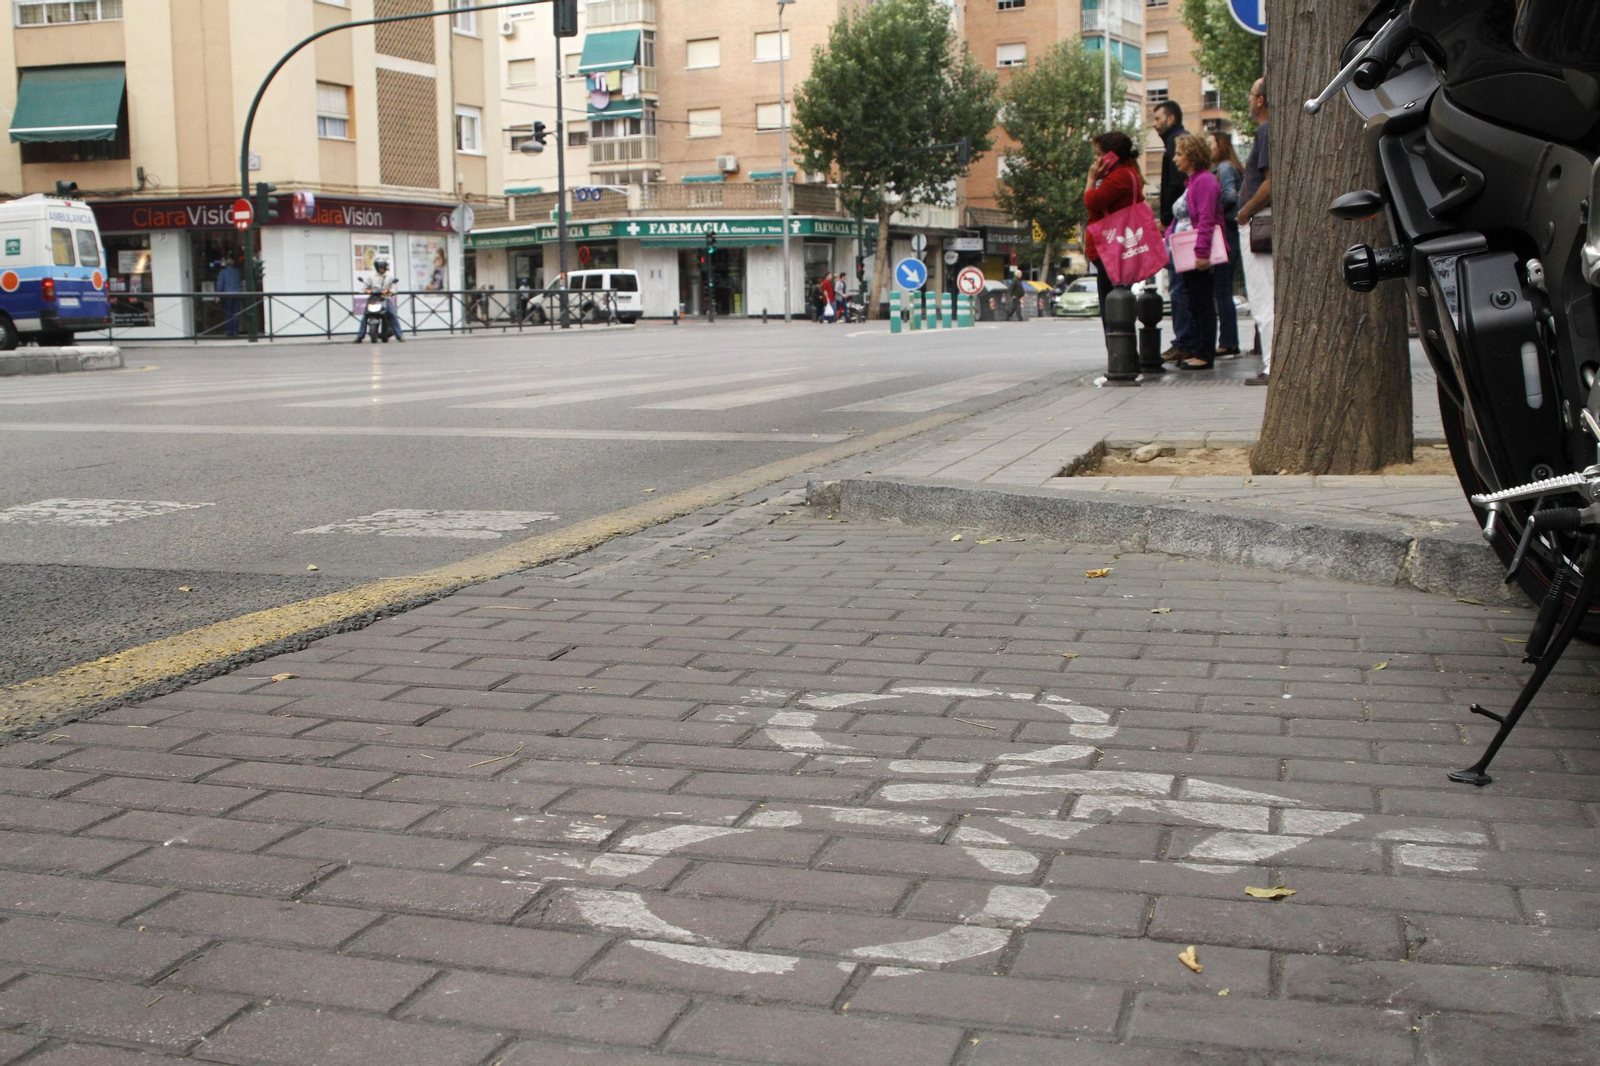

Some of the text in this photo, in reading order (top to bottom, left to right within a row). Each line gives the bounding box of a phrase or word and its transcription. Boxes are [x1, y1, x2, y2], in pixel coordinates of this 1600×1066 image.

[49, 211, 92, 224] AMBULANCIA
[649, 222, 729, 234] FARMACIA
[815, 222, 849, 234] FARMACIA
